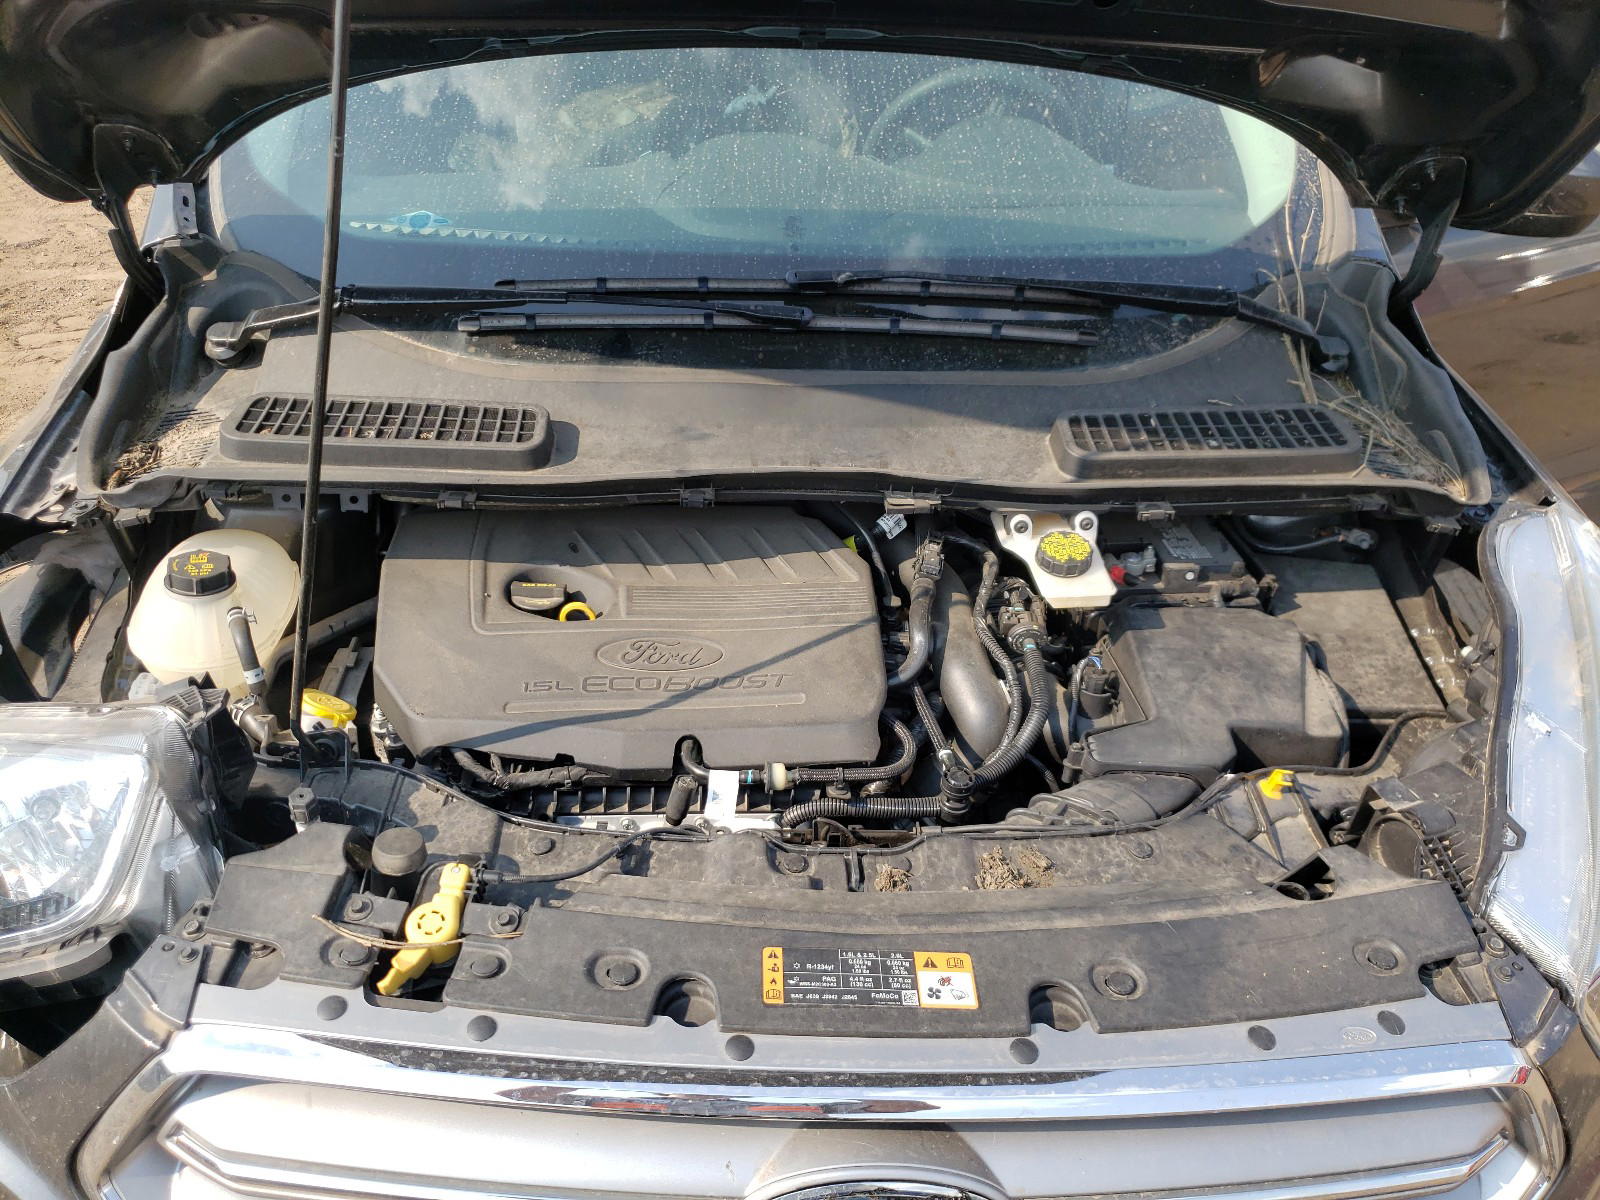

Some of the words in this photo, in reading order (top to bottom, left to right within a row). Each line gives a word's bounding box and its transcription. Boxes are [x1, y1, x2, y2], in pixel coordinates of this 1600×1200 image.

[621, 639, 704, 666] Ford
[522, 680, 574, 693] 1.5L
[580, 673, 792, 693] ECOBOOST
[806, 963, 834, 971] R-1234yf
